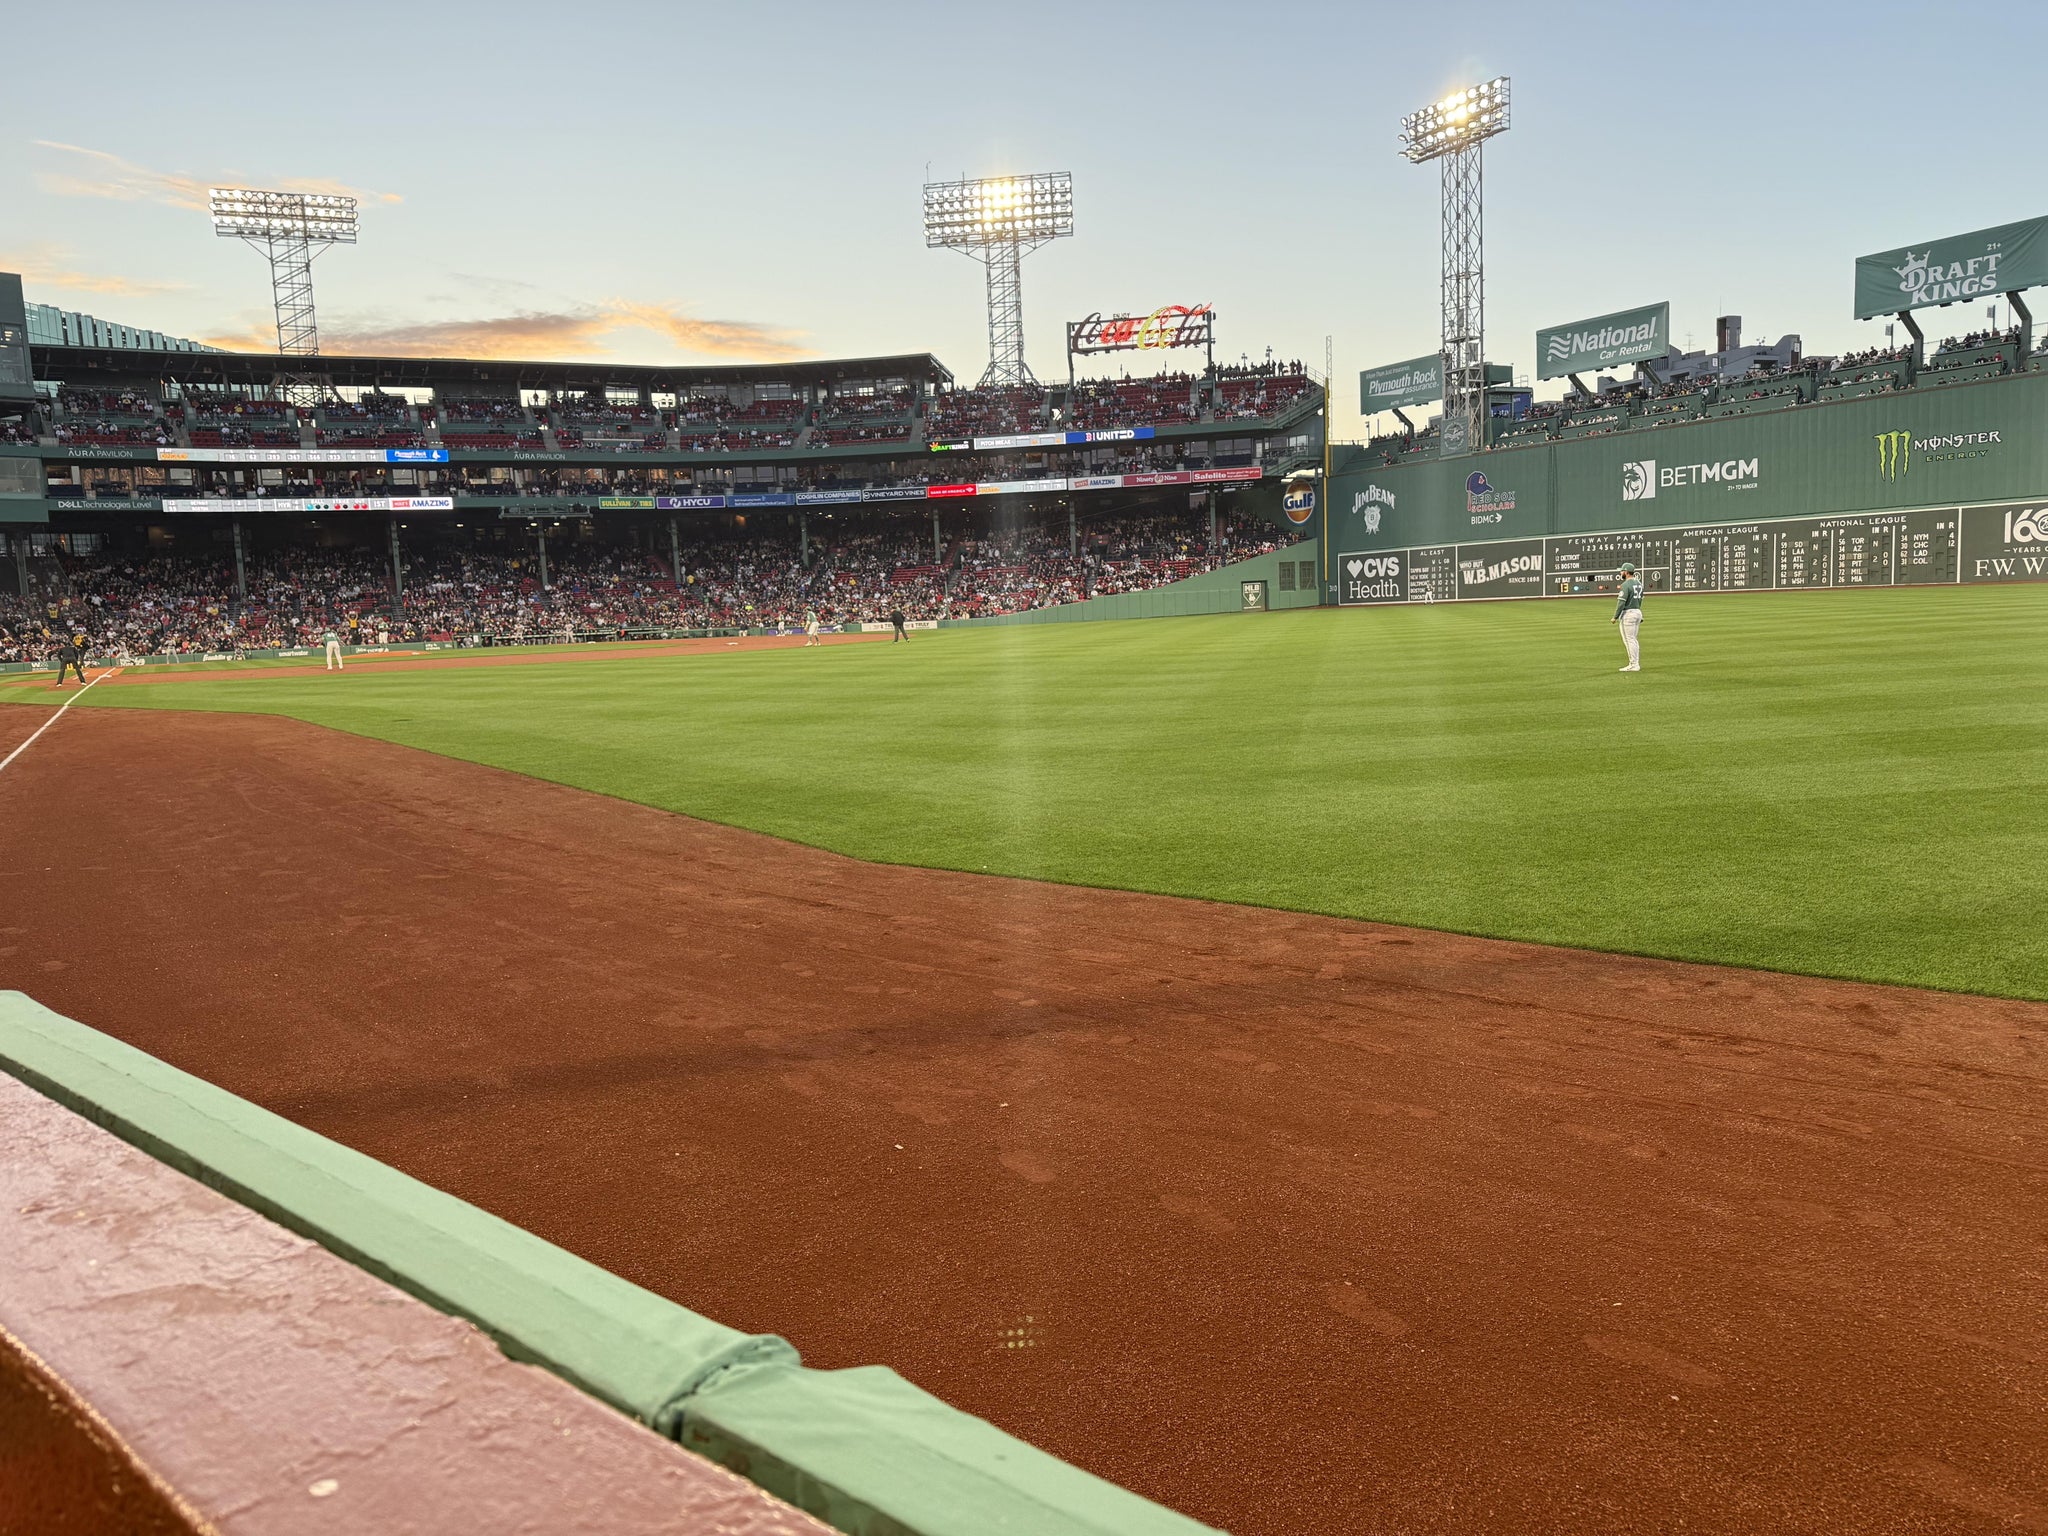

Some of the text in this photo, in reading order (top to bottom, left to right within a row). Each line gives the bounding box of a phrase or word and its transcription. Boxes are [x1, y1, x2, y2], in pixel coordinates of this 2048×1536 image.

[1899, 254, 2002, 292] DRAFT
[1910, 273, 1997, 305] KINGS
[1571, 317, 1656, 354] National
[1599, 342, 1652, 360] Car Rental
[1369, 368, 1436, 394] Plymouth Rock
[1096, 430, 1135, 440] UNITED
[1926, 450, 1988, 462] ENERGY
[1660, 458, 1758, 487] BETMGM
[82, 501, 131, 509] Technologies
[1284, 493, 1312, 510] Gulf
[1352, 485, 1396, 514] JIM BEAM
[1472, 491, 1515, 504] RED SOX
[1471, 501, 1515, 513] SCHOLARS
[1471, 514, 1494, 525] BIDMC
[1869, 516, 1906, 524] LEAGUE
[1683, 529, 1722, 537] AMERICAN
[1363, 557, 1399, 578] CVS
[1974, 558, 2015, 577] F.W.
[1349, 579, 1400, 598] Health
[1561, 583, 1568, 592] 13
